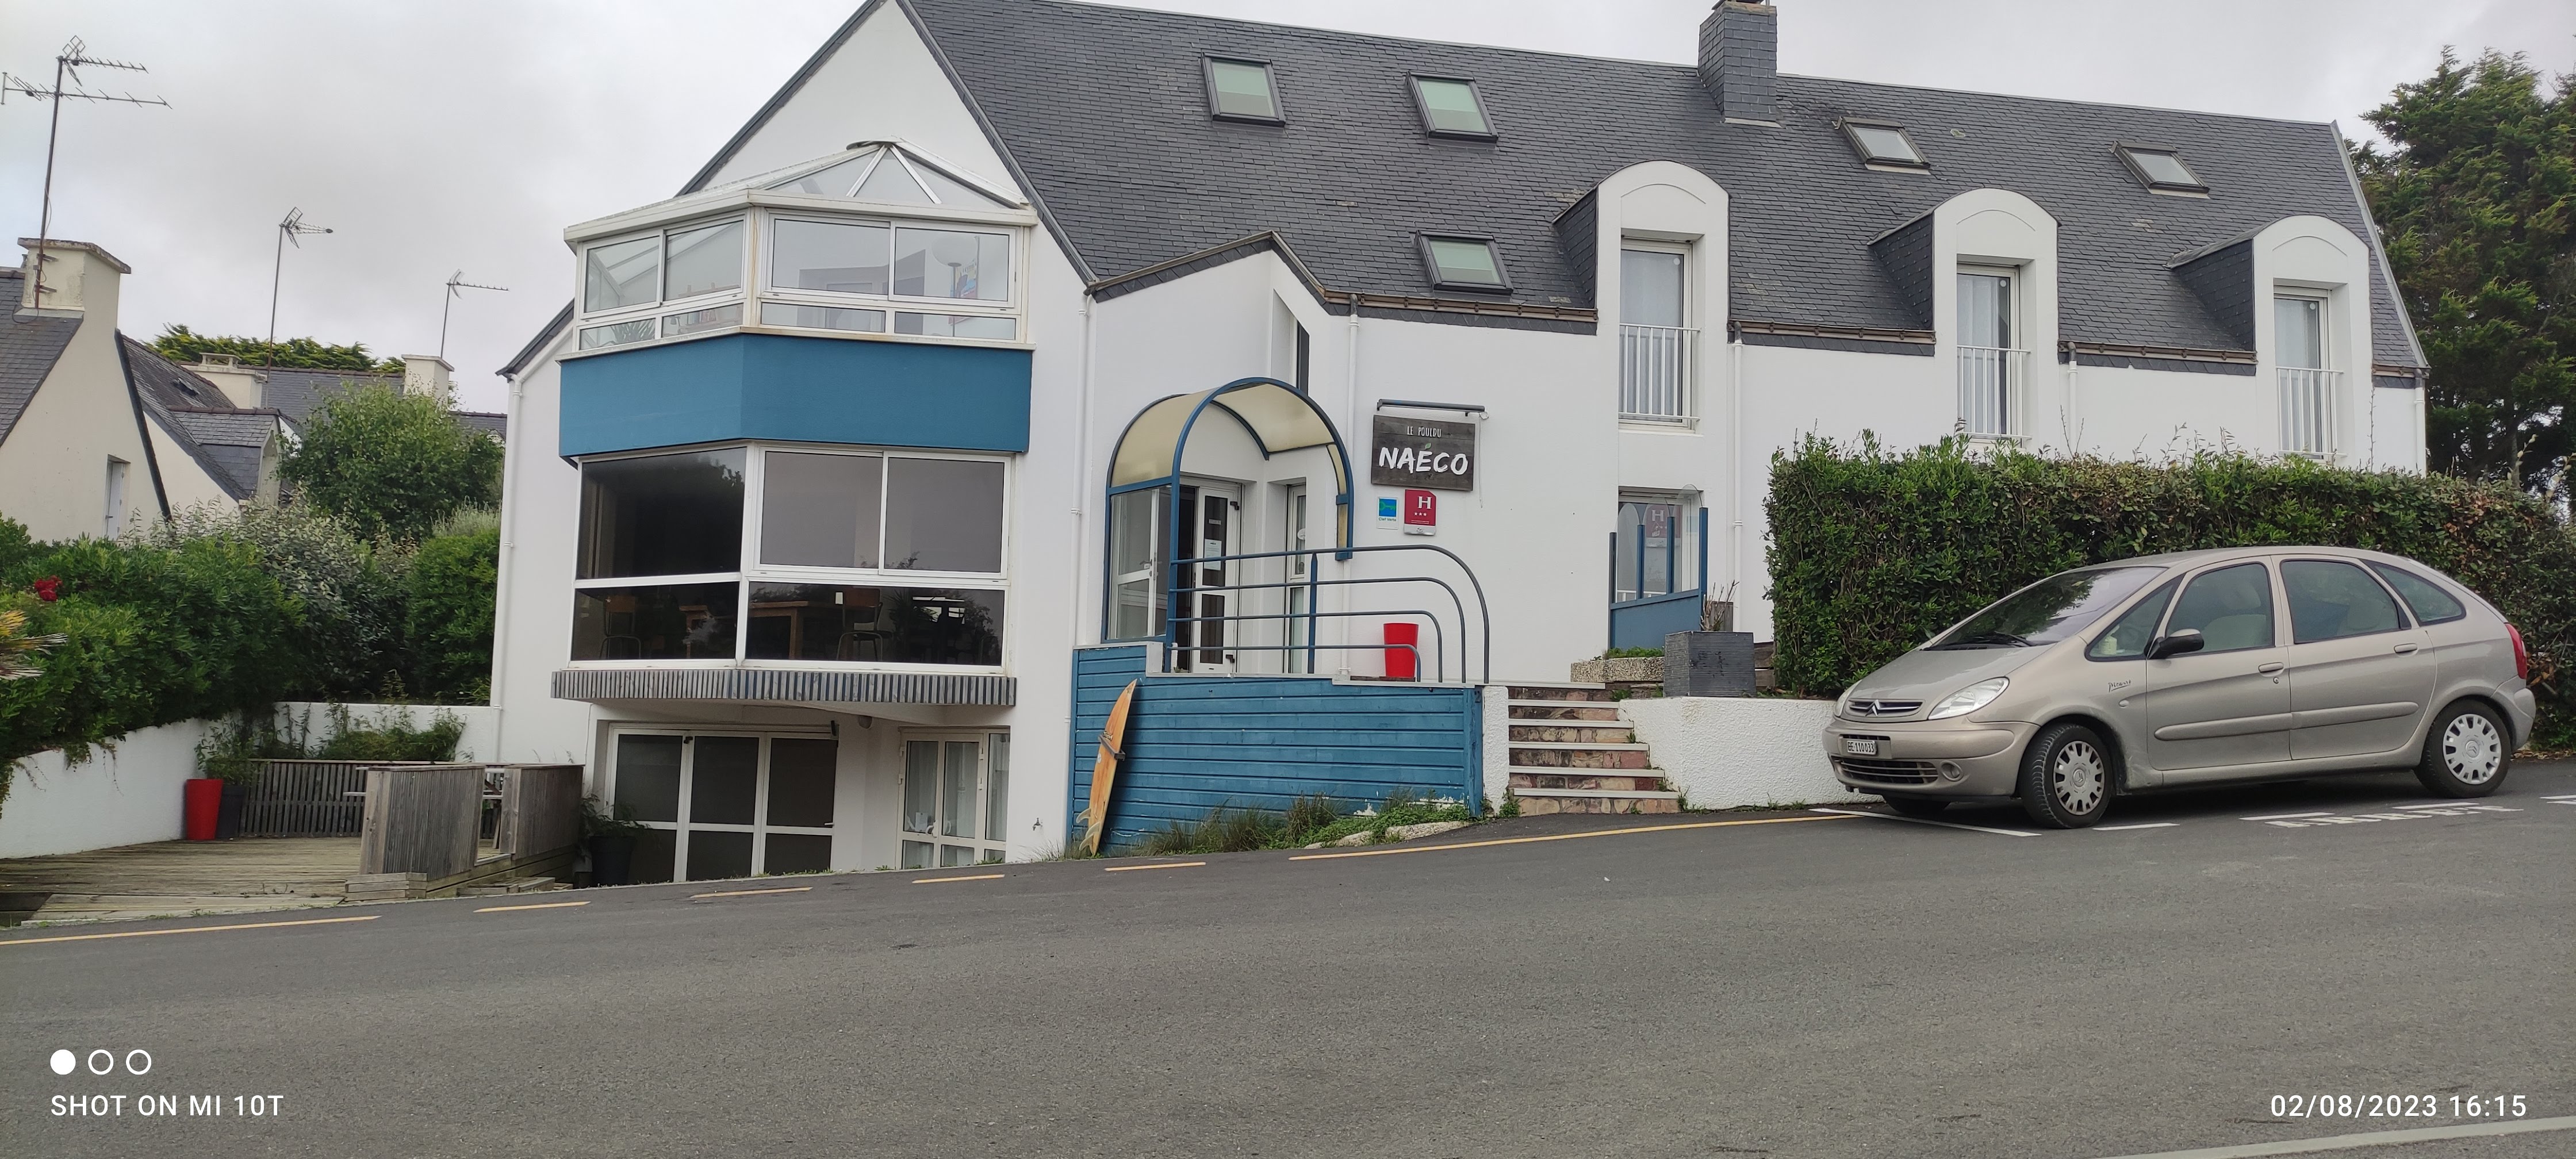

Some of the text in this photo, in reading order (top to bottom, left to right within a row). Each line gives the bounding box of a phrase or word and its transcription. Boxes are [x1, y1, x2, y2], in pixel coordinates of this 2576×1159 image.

[1407, 425, 1442, 437] LE POULDU
[1379, 443, 1469, 475] NAÉCO
[1417, 496, 1432, 509] H
